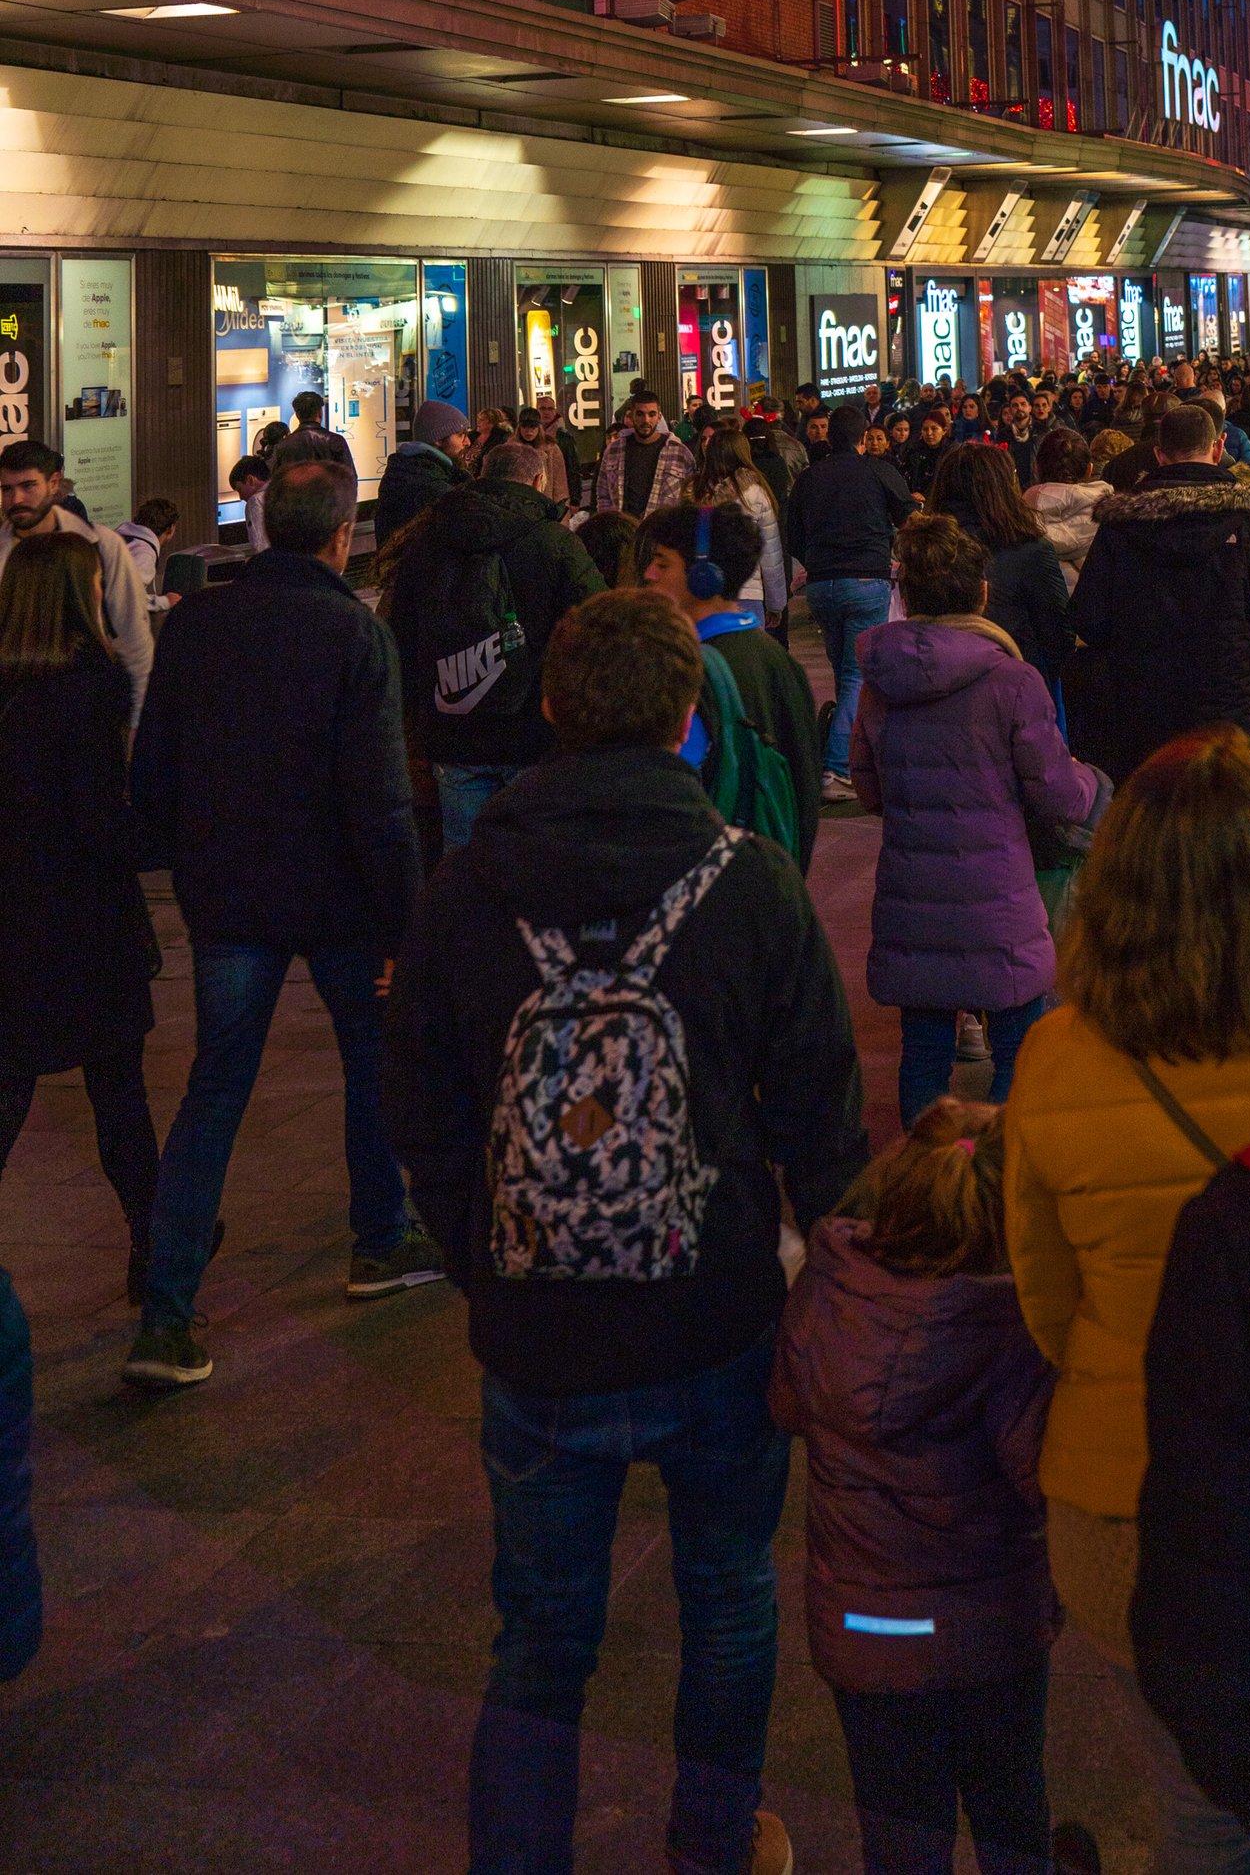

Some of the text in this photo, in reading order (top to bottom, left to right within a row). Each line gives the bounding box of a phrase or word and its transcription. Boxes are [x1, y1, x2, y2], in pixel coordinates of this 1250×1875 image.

[1161, 20, 1220, 133] fnac
[216, 307, 265, 337] Midea
[927, 279, 958, 314] fnac
[1124, 278, 1143, 304] fnac
[1163, 296, 1184, 333] fnac
[707, 319, 735, 411] fnac
[819, 309, 877, 371] fnac
[568, 326, 601, 430] fnac
[436, 630, 504, 696] NIKE
